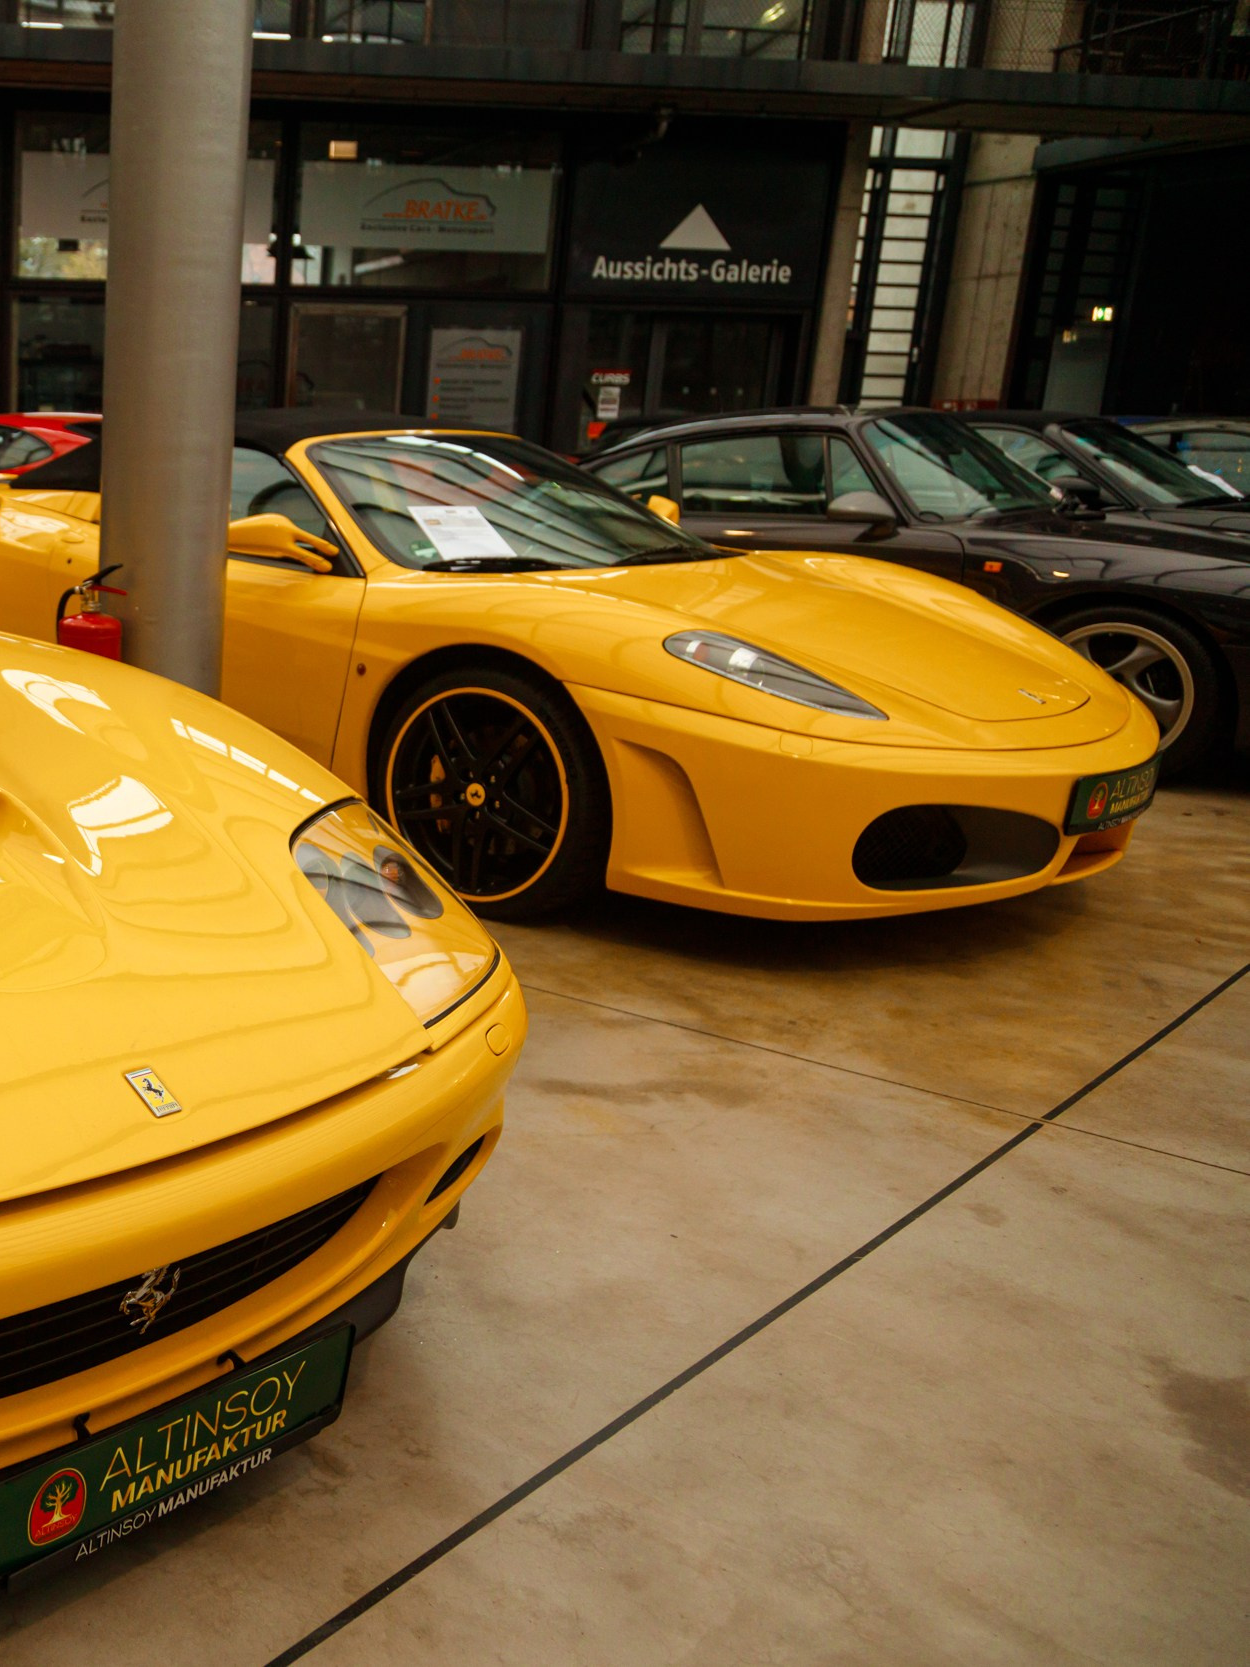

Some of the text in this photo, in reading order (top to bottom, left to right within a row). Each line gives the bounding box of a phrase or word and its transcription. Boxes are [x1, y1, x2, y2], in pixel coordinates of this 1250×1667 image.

[592, 256, 792, 284] Aussichts-Galerie
[99, 1360, 306, 1492] ALTINSOY
[111, 1409, 287, 1513] MANUFAKTUR
[75, 1448, 272, 1561] ALTINSOY MANUFAKTUR
